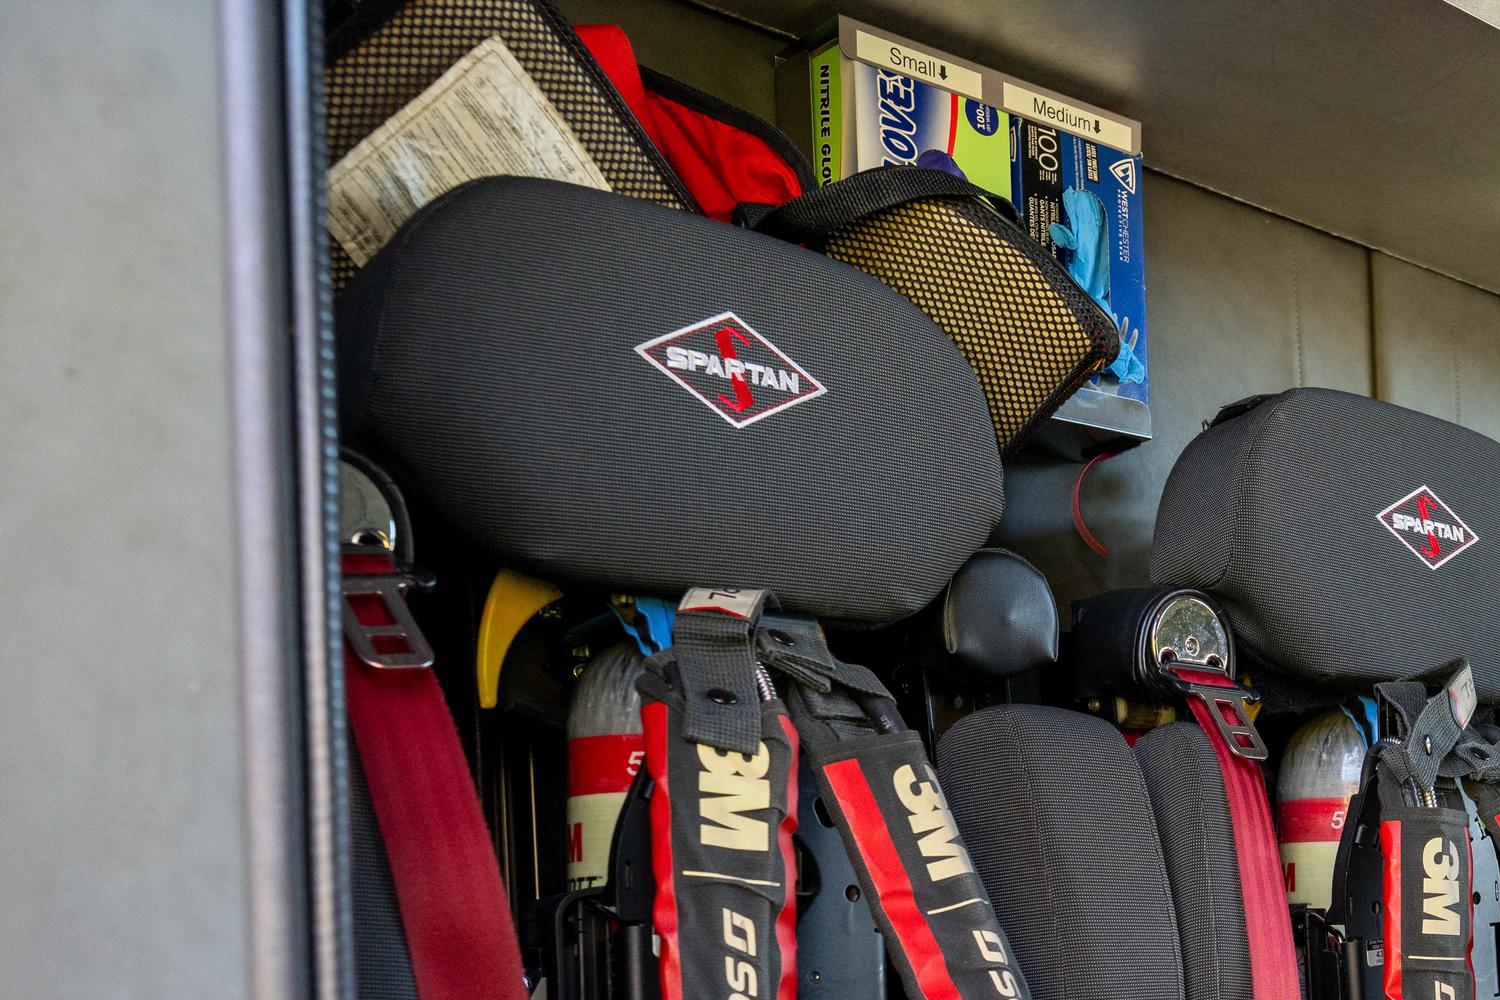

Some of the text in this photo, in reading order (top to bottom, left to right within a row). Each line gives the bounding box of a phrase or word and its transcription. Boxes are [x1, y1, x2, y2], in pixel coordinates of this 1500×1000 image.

[890, 47, 936, 78] Small
[819, 65, 832, 183] NITRILE GLOV
[1033, 98, 1091, 132] Medium
[1037, 128, 1058, 171] 100
[1121, 190, 1130, 263] WESTCHESTER
[665, 345, 800, 395] SPARTAN
[1392, 512, 1467, 545] SPARTAN
[697, 742, 771, 852] 3M
[892, 763, 974, 883] 3M
[1421, 836, 1462, 936] 3M
